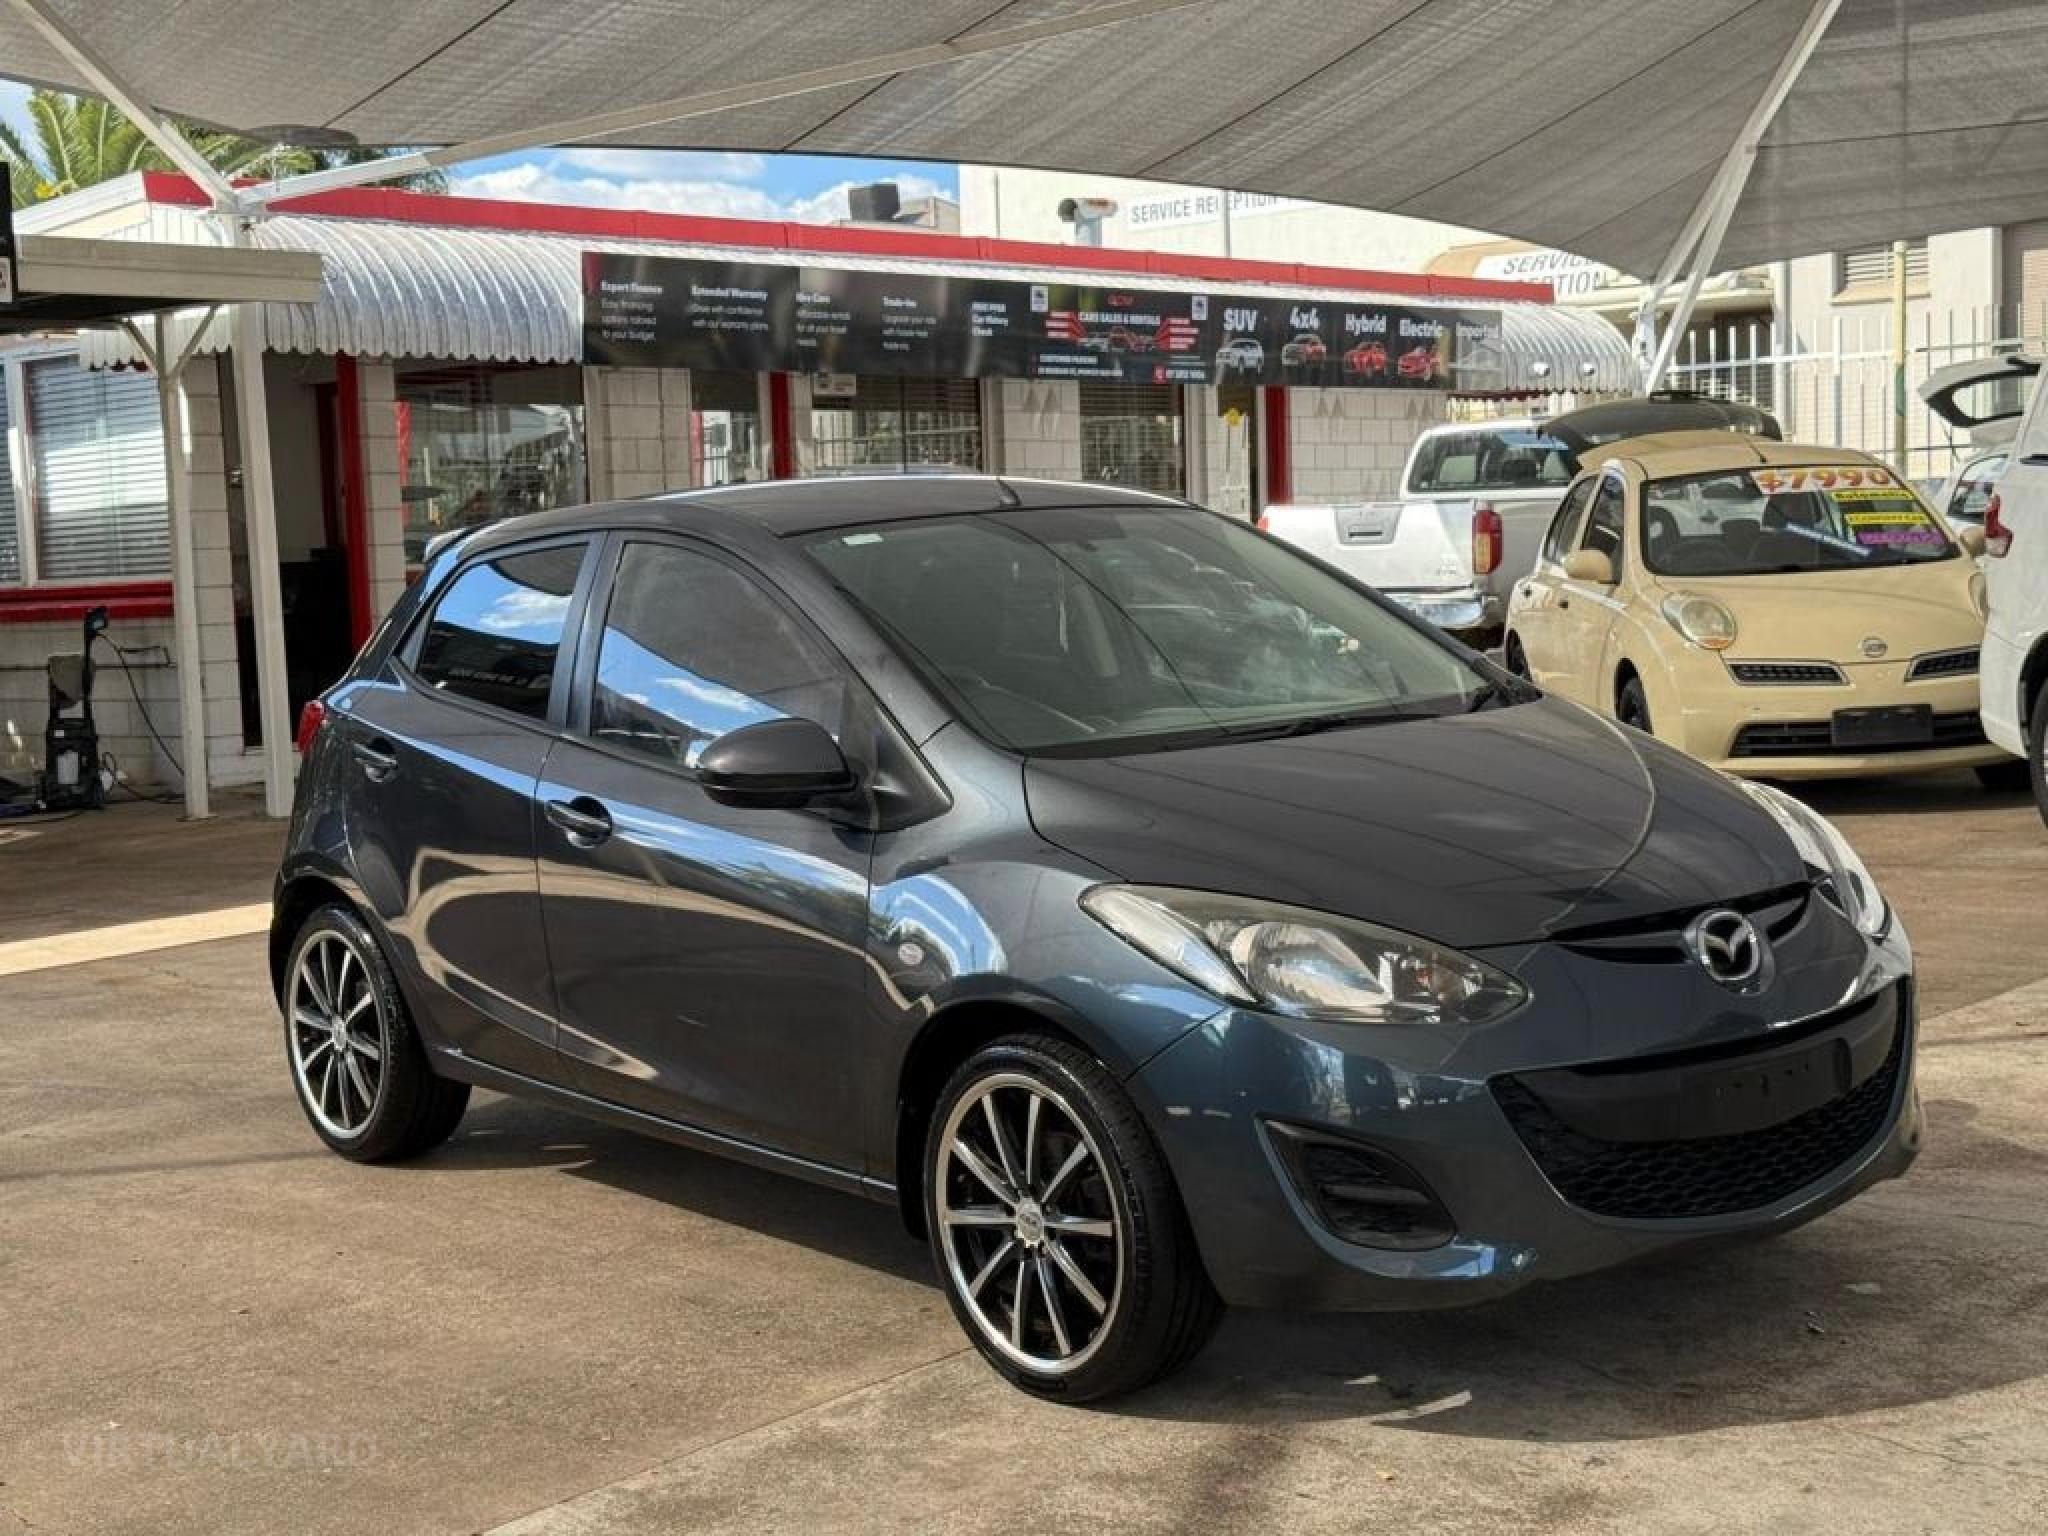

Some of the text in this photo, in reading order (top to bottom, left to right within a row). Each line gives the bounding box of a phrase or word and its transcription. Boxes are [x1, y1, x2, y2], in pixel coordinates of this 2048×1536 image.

[1131, 199, 1192, 223] SERVICE
[631, 282, 663, 294] Finance
[691, 284, 768, 302] Extended Warranty
[1077, 311, 1099, 322] CARS
[1101, 312, 1123, 324] SALES
[1223, 307, 1258, 332] SUV
[1289, 306, 1320, 331] 4x4
[1345, 313, 1387, 336] Hybrid
[1399, 317, 1444, 339] Electric
[1758, 468, 1891, 493] $7990
